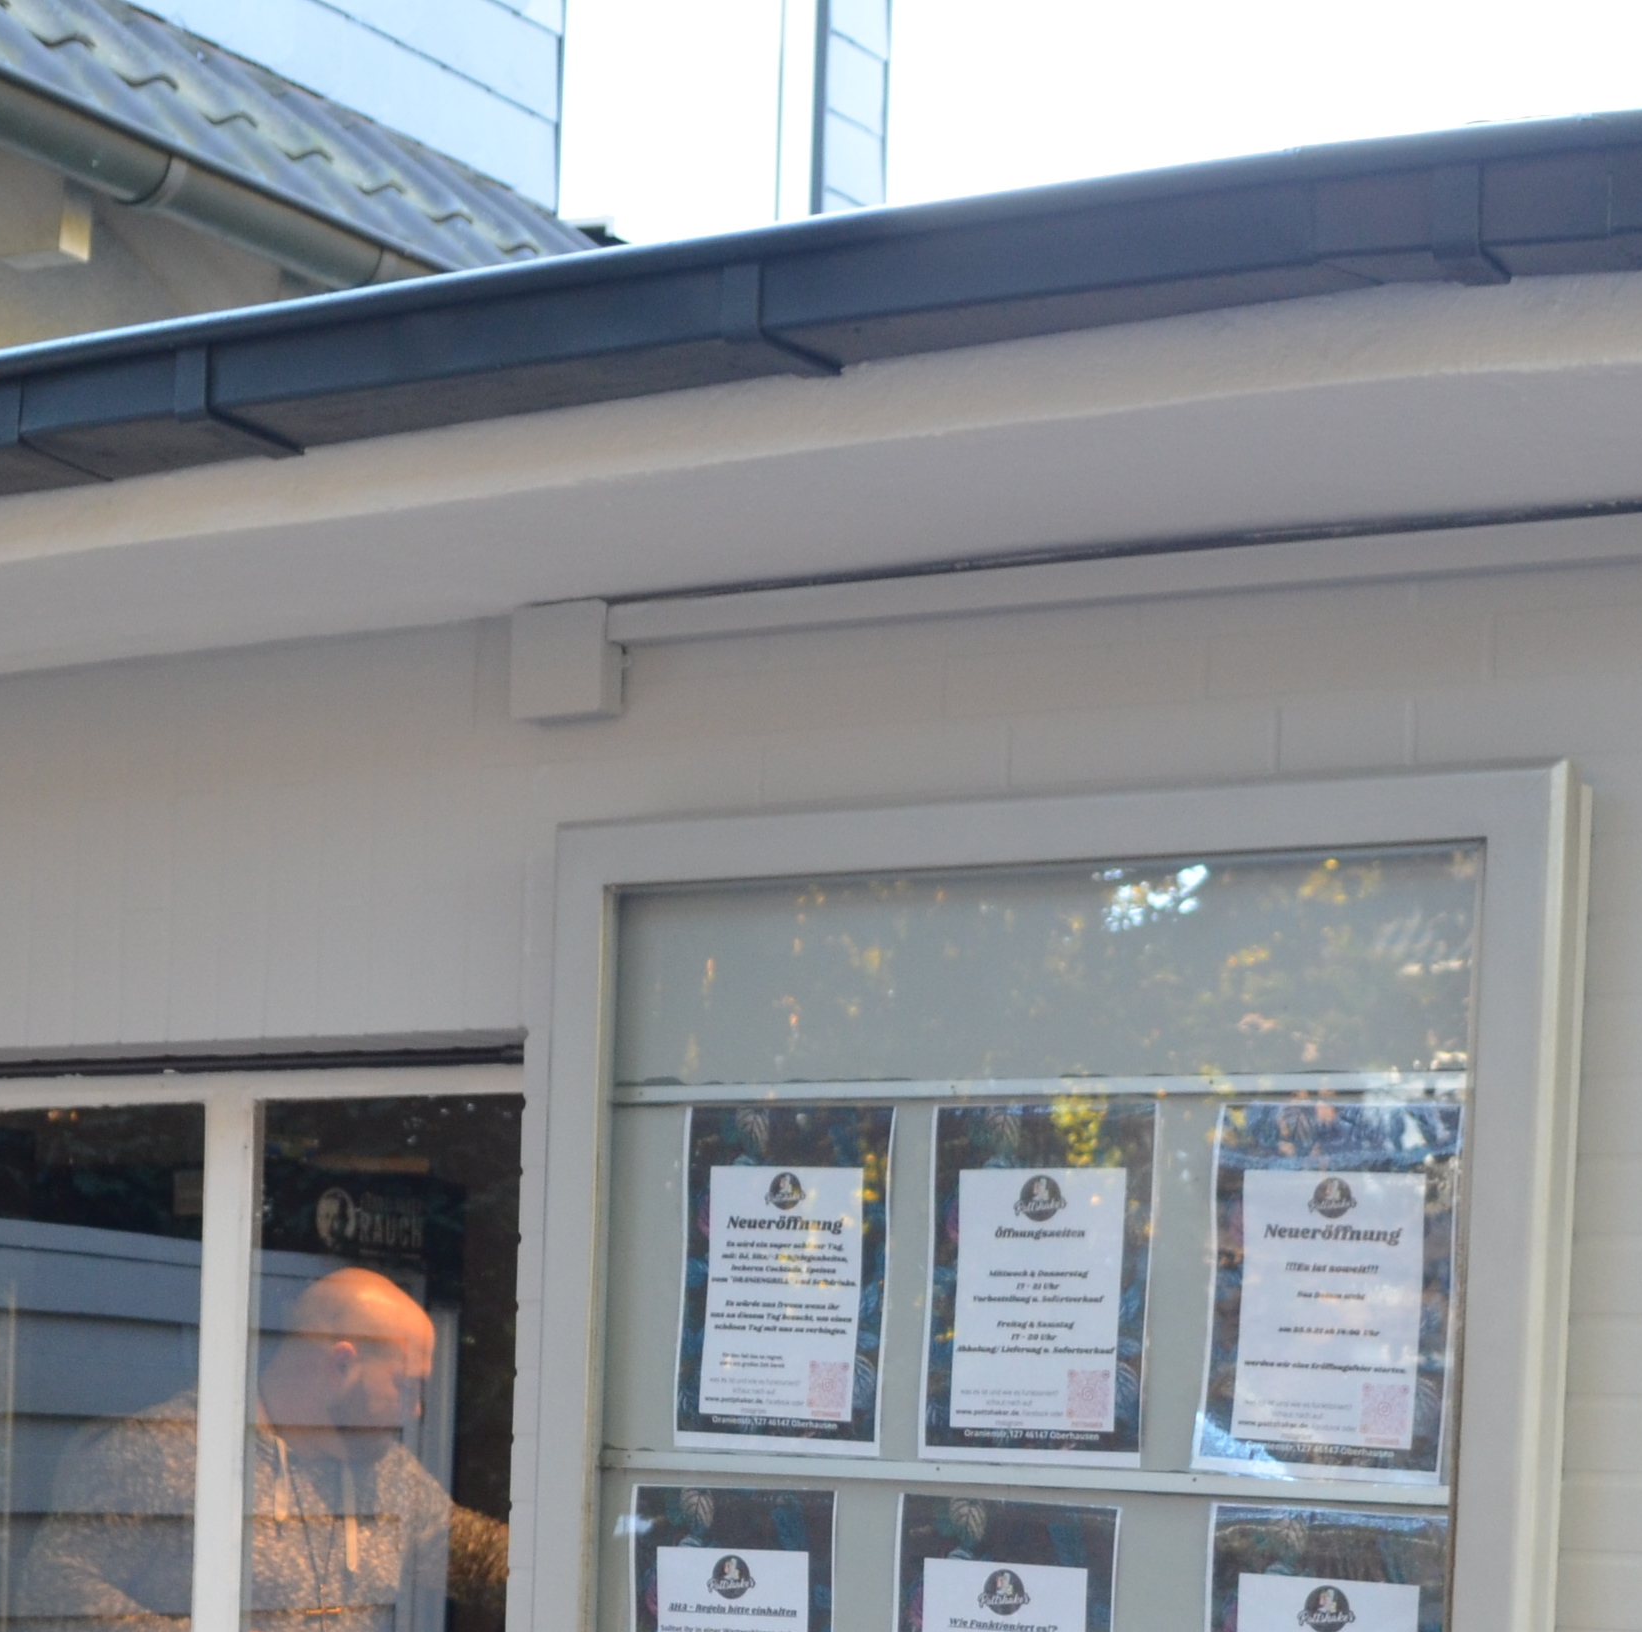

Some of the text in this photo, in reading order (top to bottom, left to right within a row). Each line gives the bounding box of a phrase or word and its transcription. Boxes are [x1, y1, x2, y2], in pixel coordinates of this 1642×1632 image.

[727, 1216, 843, 1235] Neueröffnung
[995, 1226, 1086, 1240] Öffnungszeiten
[1264, 1223, 1403, 1247] Neueröffnung
[1311, 1264, 1327, 1272] ist
[1042, 1282, 1059, 1290] Uhr
[972, 1295, 1031, 1303] Vorbestellung
[996, 1320, 1027, 1329] Freitag
[1036, 1321, 1074, 1329] Samstag
[1040, 1333, 1056, 1341] Uhr
[1000, 1346, 1042, 1354] Lieferung
[767, 1417, 790, 1426] 46147
[790, 1418, 837, 1429] Oberhausen
[1024, 1429, 1048, 1439] 46147
[1049, 1430, 1099, 1440] Oberhausen
[1339, 1444, 1394, 1458] Oberhausen
[668, 1602, 687, 1612] AHA
[695, 1603, 726, 1614] Regeln
[727, 1605, 749, 1615] bitte
[751, 1606, 797, 1617] einhalten
[660, 1624, 682, 1632] Solltet
[949, 1617, 968, 1628] Wie
[969, 1619, 1034, 1632] Funktioniert
